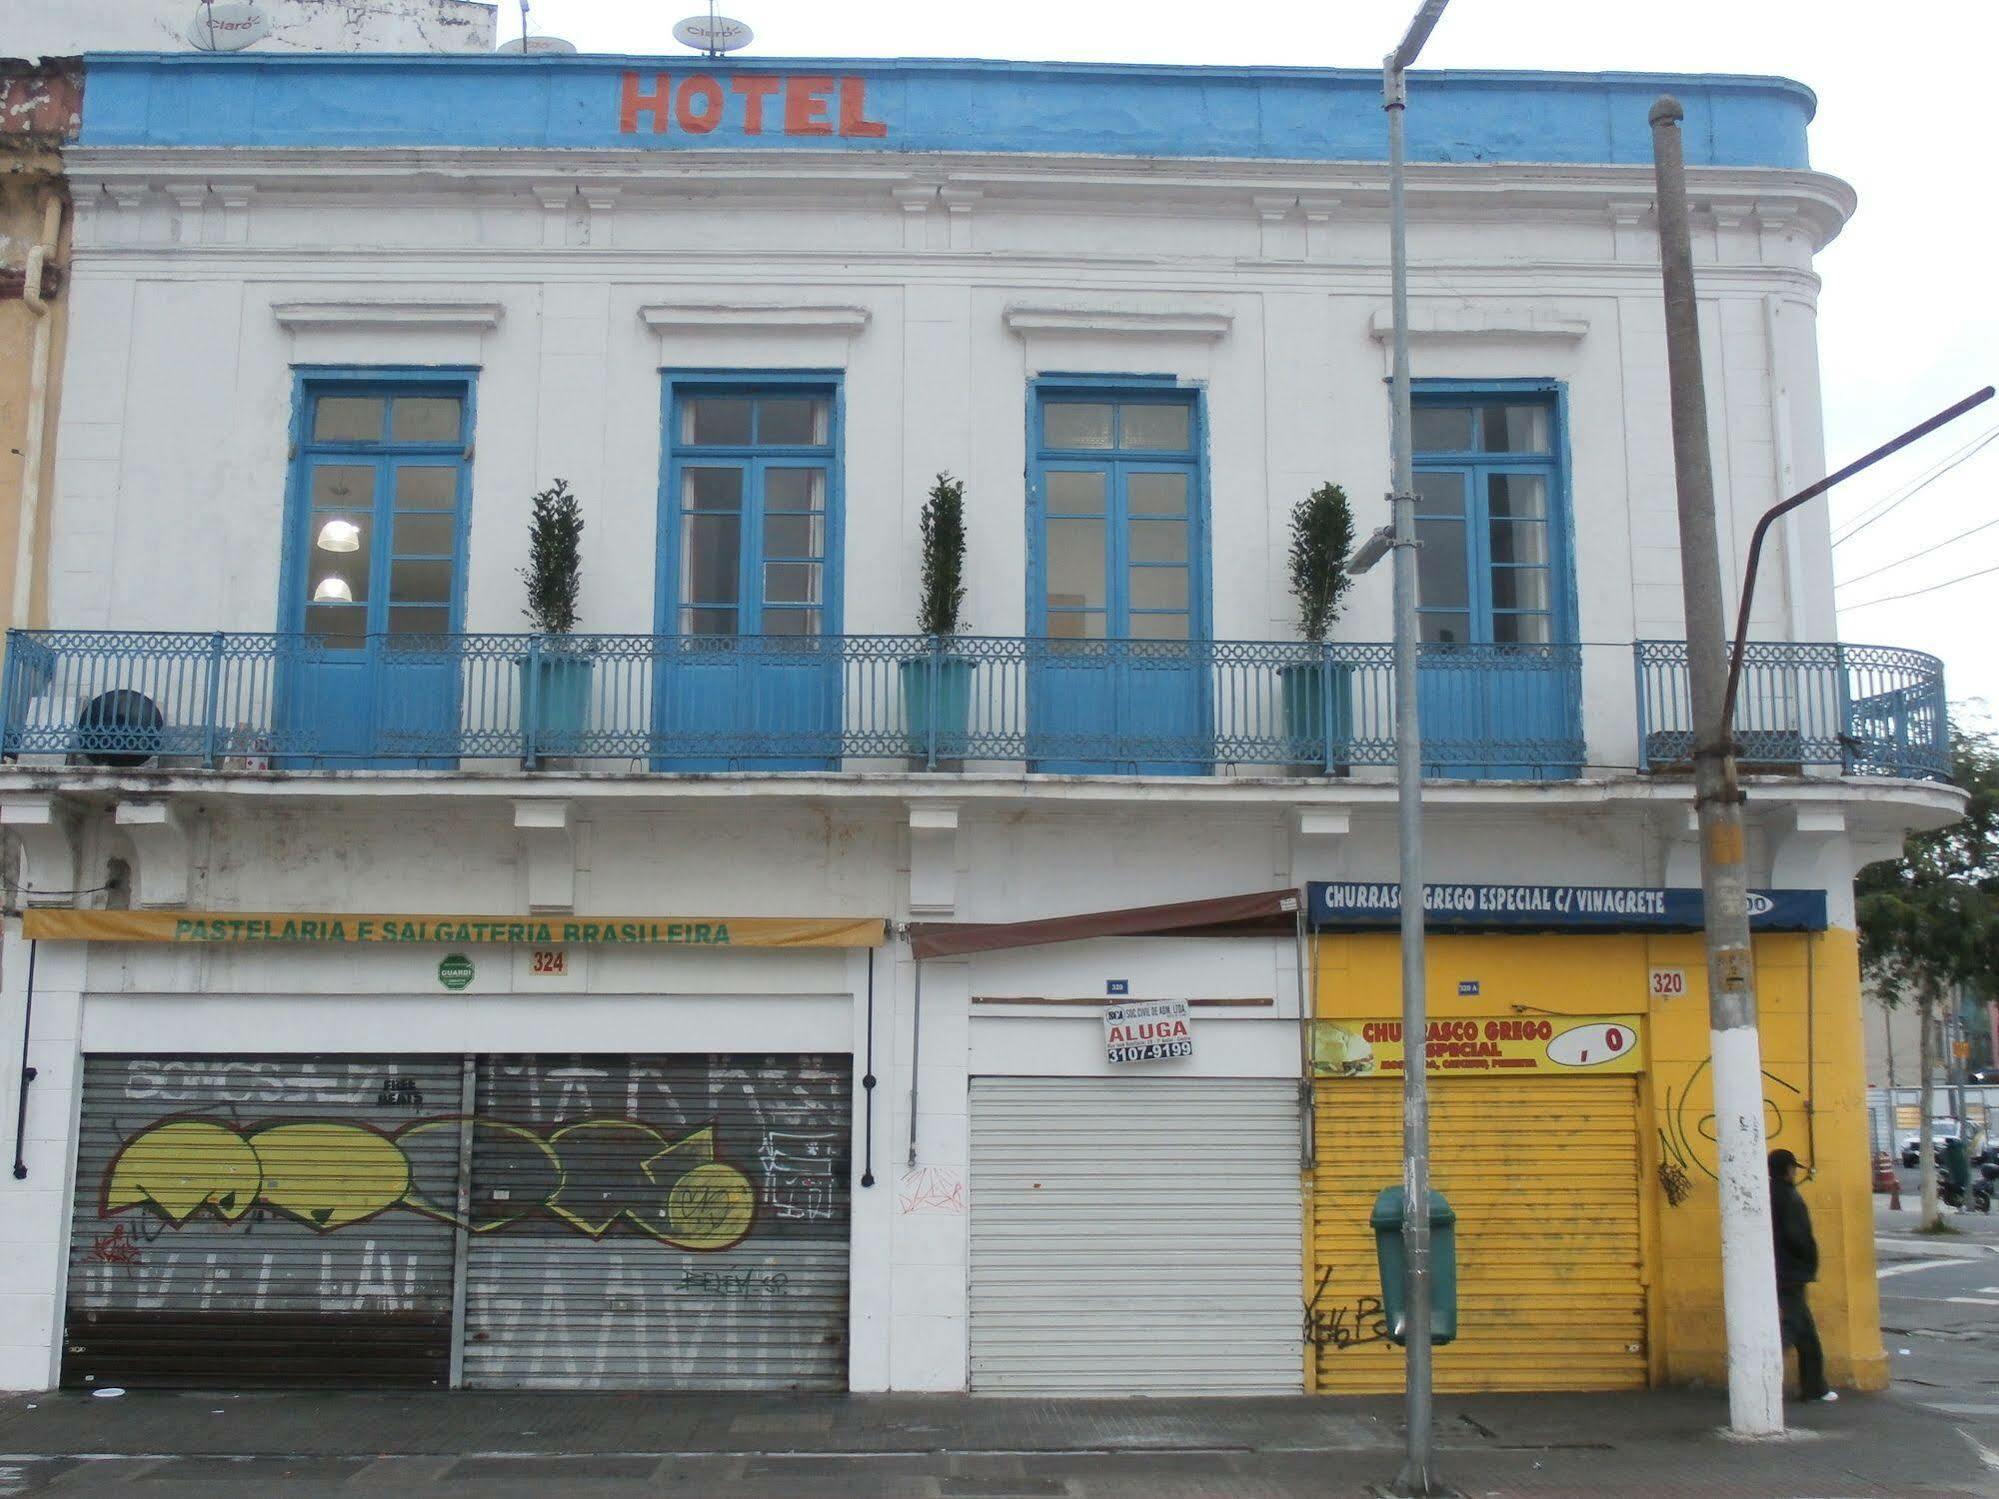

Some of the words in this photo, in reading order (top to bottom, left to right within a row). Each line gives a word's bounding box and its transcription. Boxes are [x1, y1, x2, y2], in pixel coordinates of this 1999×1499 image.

[206, 19, 253, 31] Claro
[687, 26, 734, 38] Claro
[619, 71, 888, 138] HOTEL
[1325, 885, 1401, 908] CHURRAS
[1423, 887, 1475, 911] GREGO
[1479, 887, 1551, 911] ESPECIAL
[1554, 888, 1573, 913] C/
[1576, 890, 1665, 914] VINAGRETE
[175, 919, 346, 943] PASTELARIA
[357, 921, 374, 943] E
[381, 922, 551, 944] SALGATERIA
[563, 923, 732, 945] BRASILEIRA
[533, 952, 564, 972] 324
[1653, 973, 1682, 993] 320
[1109, 1021, 1188, 1043] ALUGA
[1362, 1022, 1479, 1043] CHUASCO
[1484, 1020, 1553, 1041] GREGO
[1108, 1042, 1192, 1063] 3107-9199
[1425, 1042, 1503, 1058] SPECIAL
